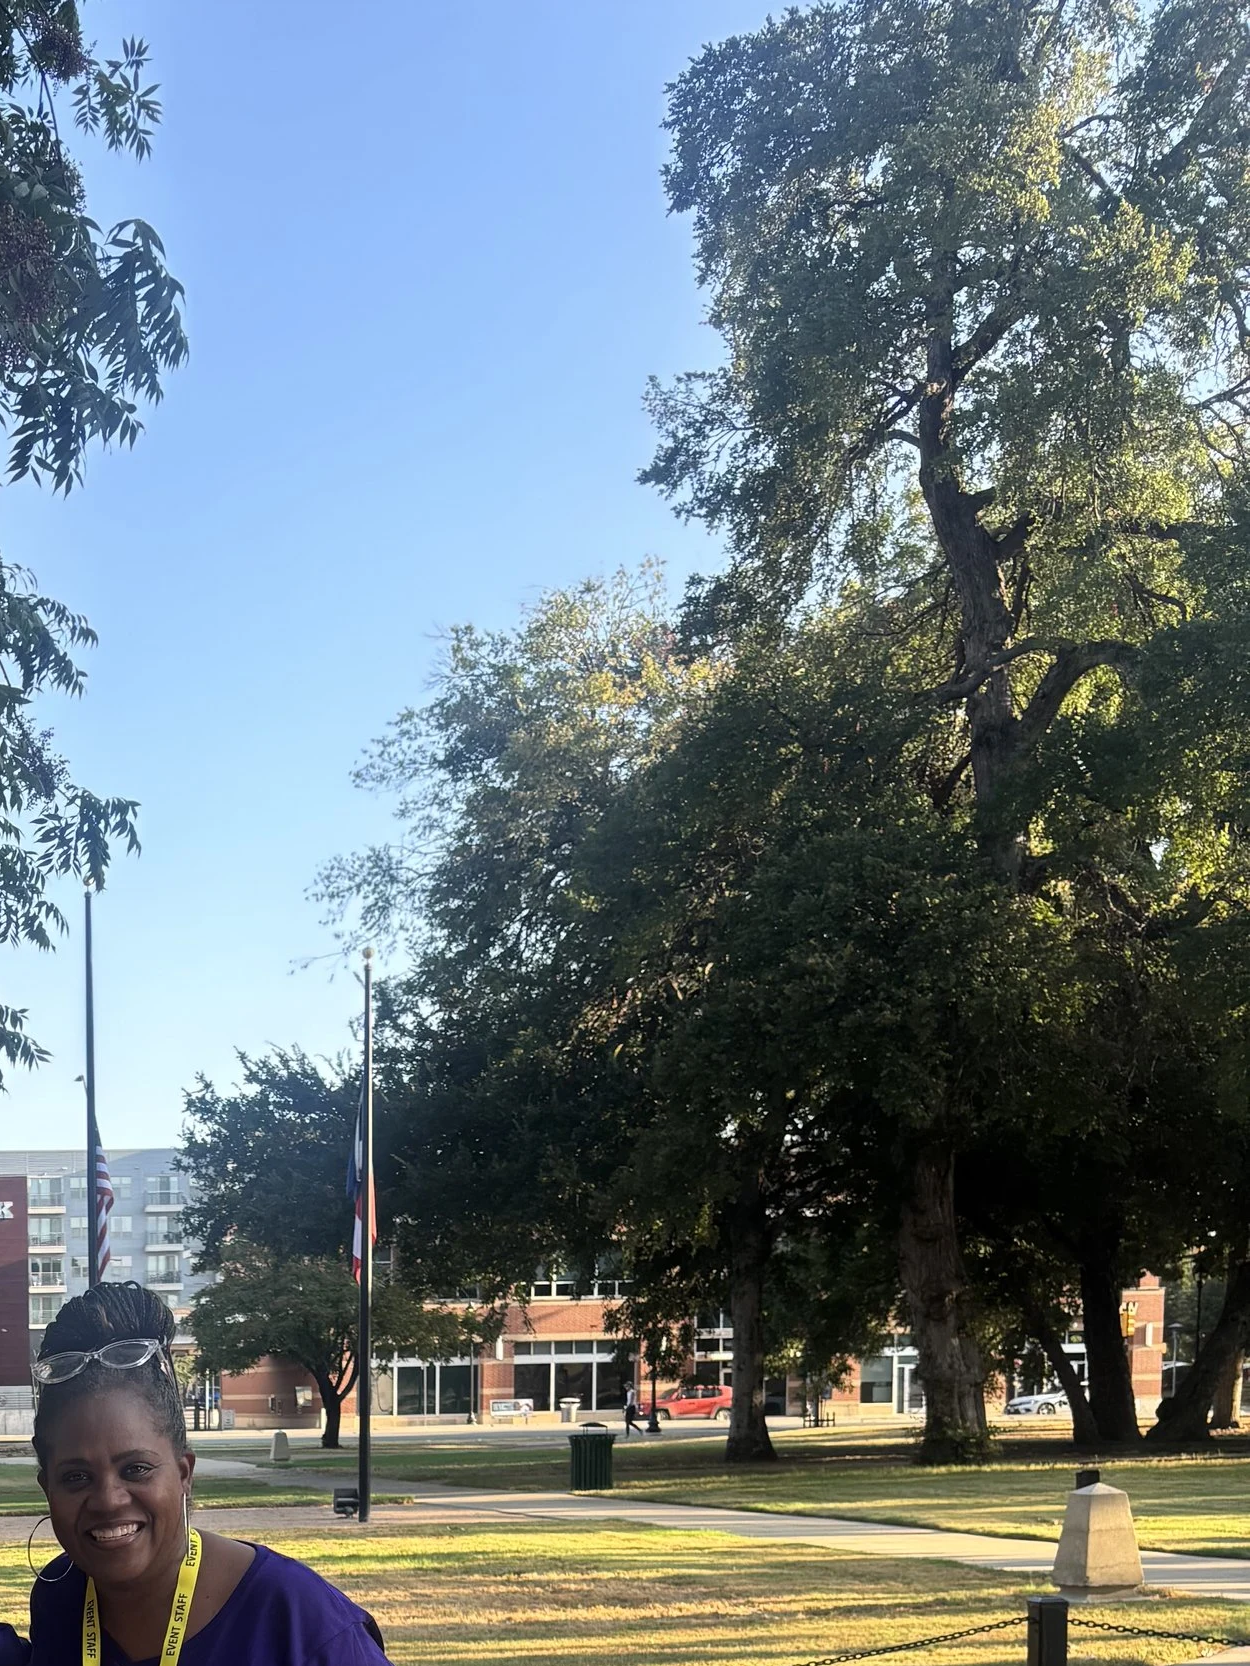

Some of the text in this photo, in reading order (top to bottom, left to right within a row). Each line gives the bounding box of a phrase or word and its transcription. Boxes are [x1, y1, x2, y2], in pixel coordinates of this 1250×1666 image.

[86, 1599, 96, 1659] EVENT STAFF
[165, 1593, 189, 1657] EVENT STAFF
